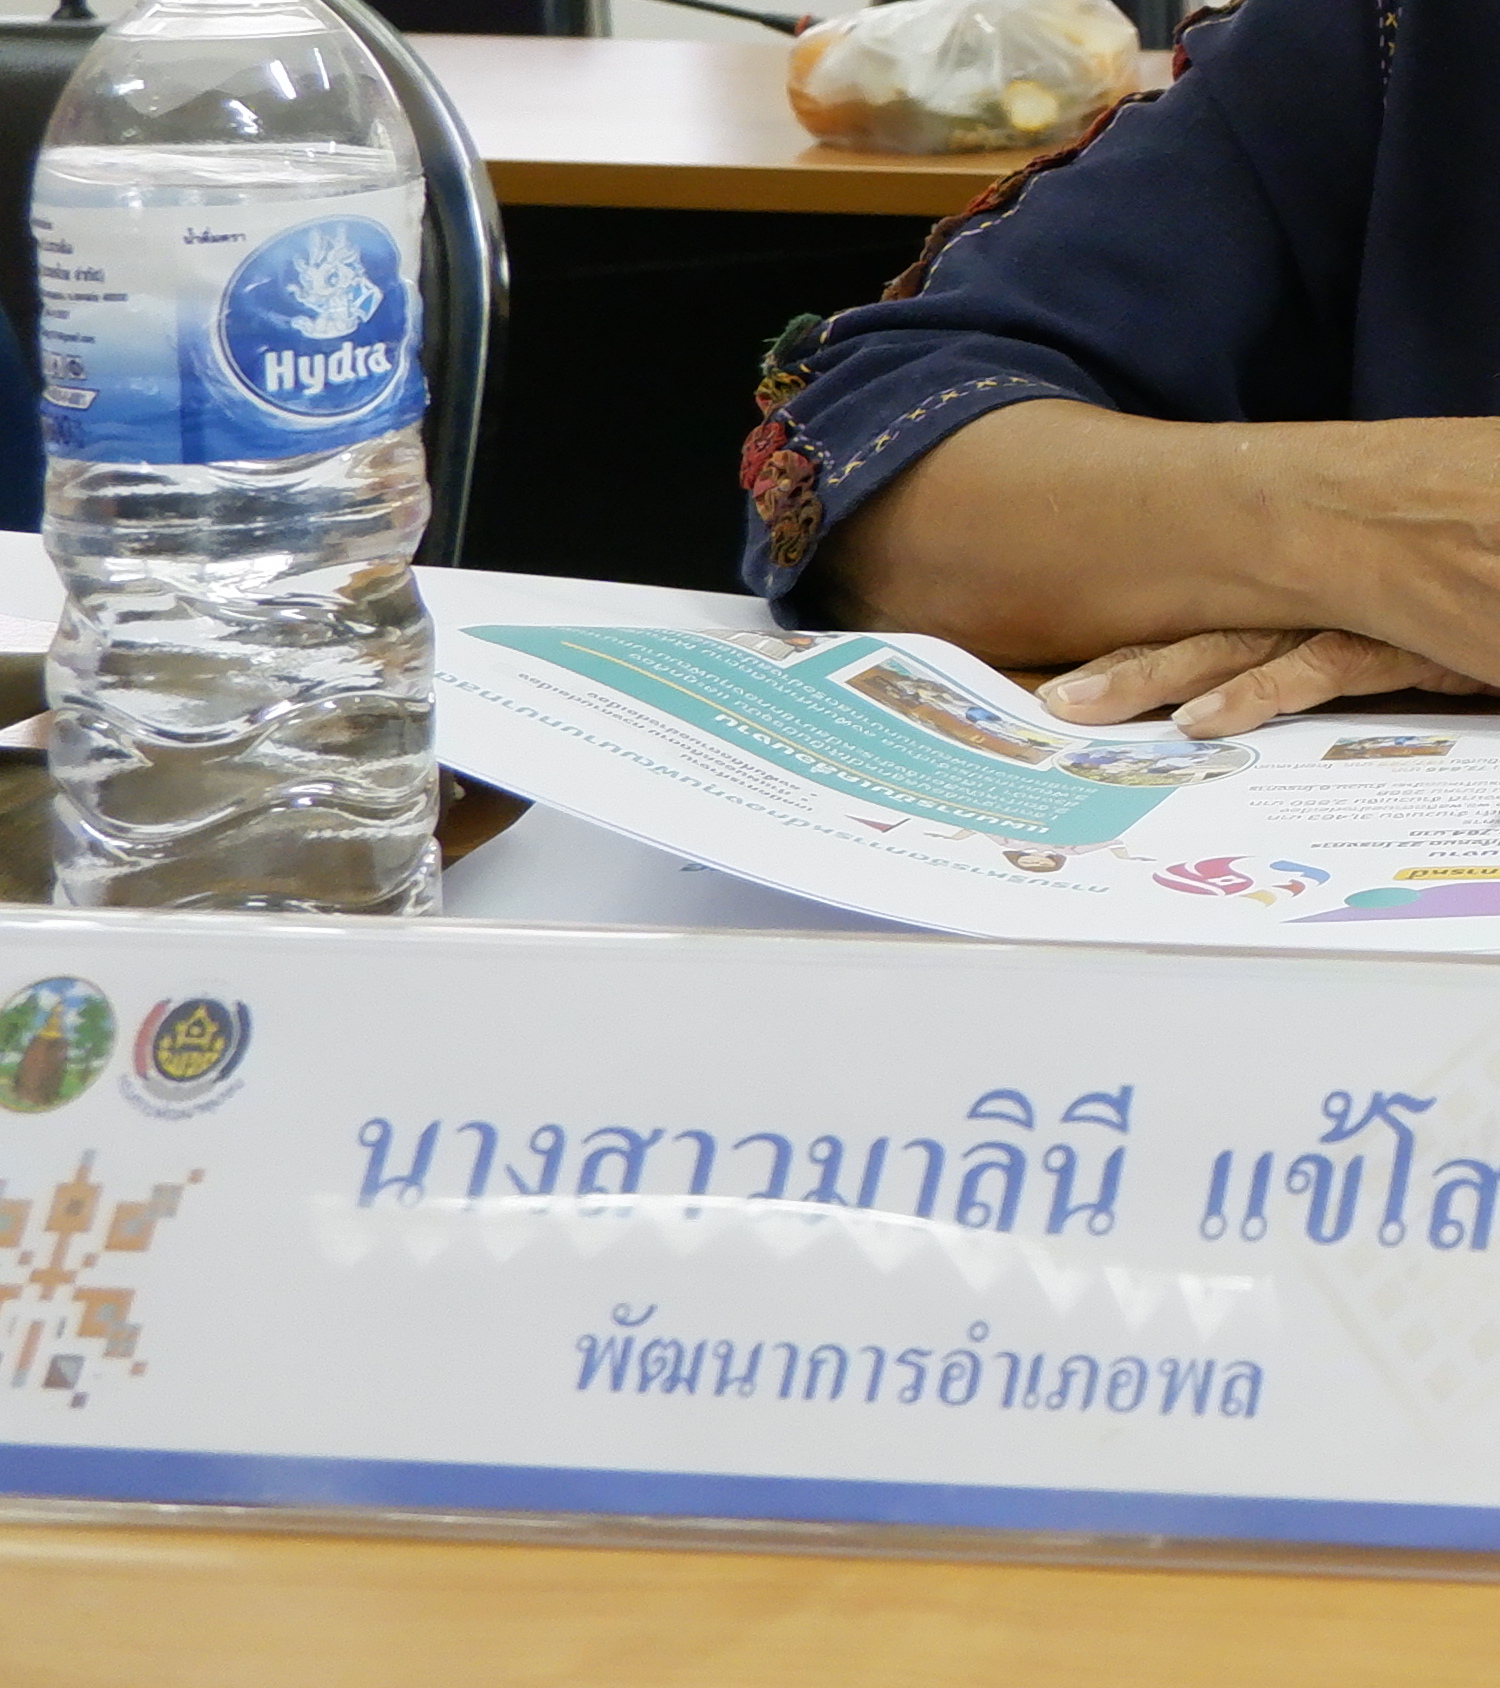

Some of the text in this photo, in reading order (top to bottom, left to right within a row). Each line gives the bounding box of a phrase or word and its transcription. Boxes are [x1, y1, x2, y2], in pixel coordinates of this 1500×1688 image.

[264, 342, 392, 394] Hydra
[355, 1085, 1135, 1237] นางสาวมาลินี
[574, 1302, 1266, 1419] พัฒนาการอำเภอพล
